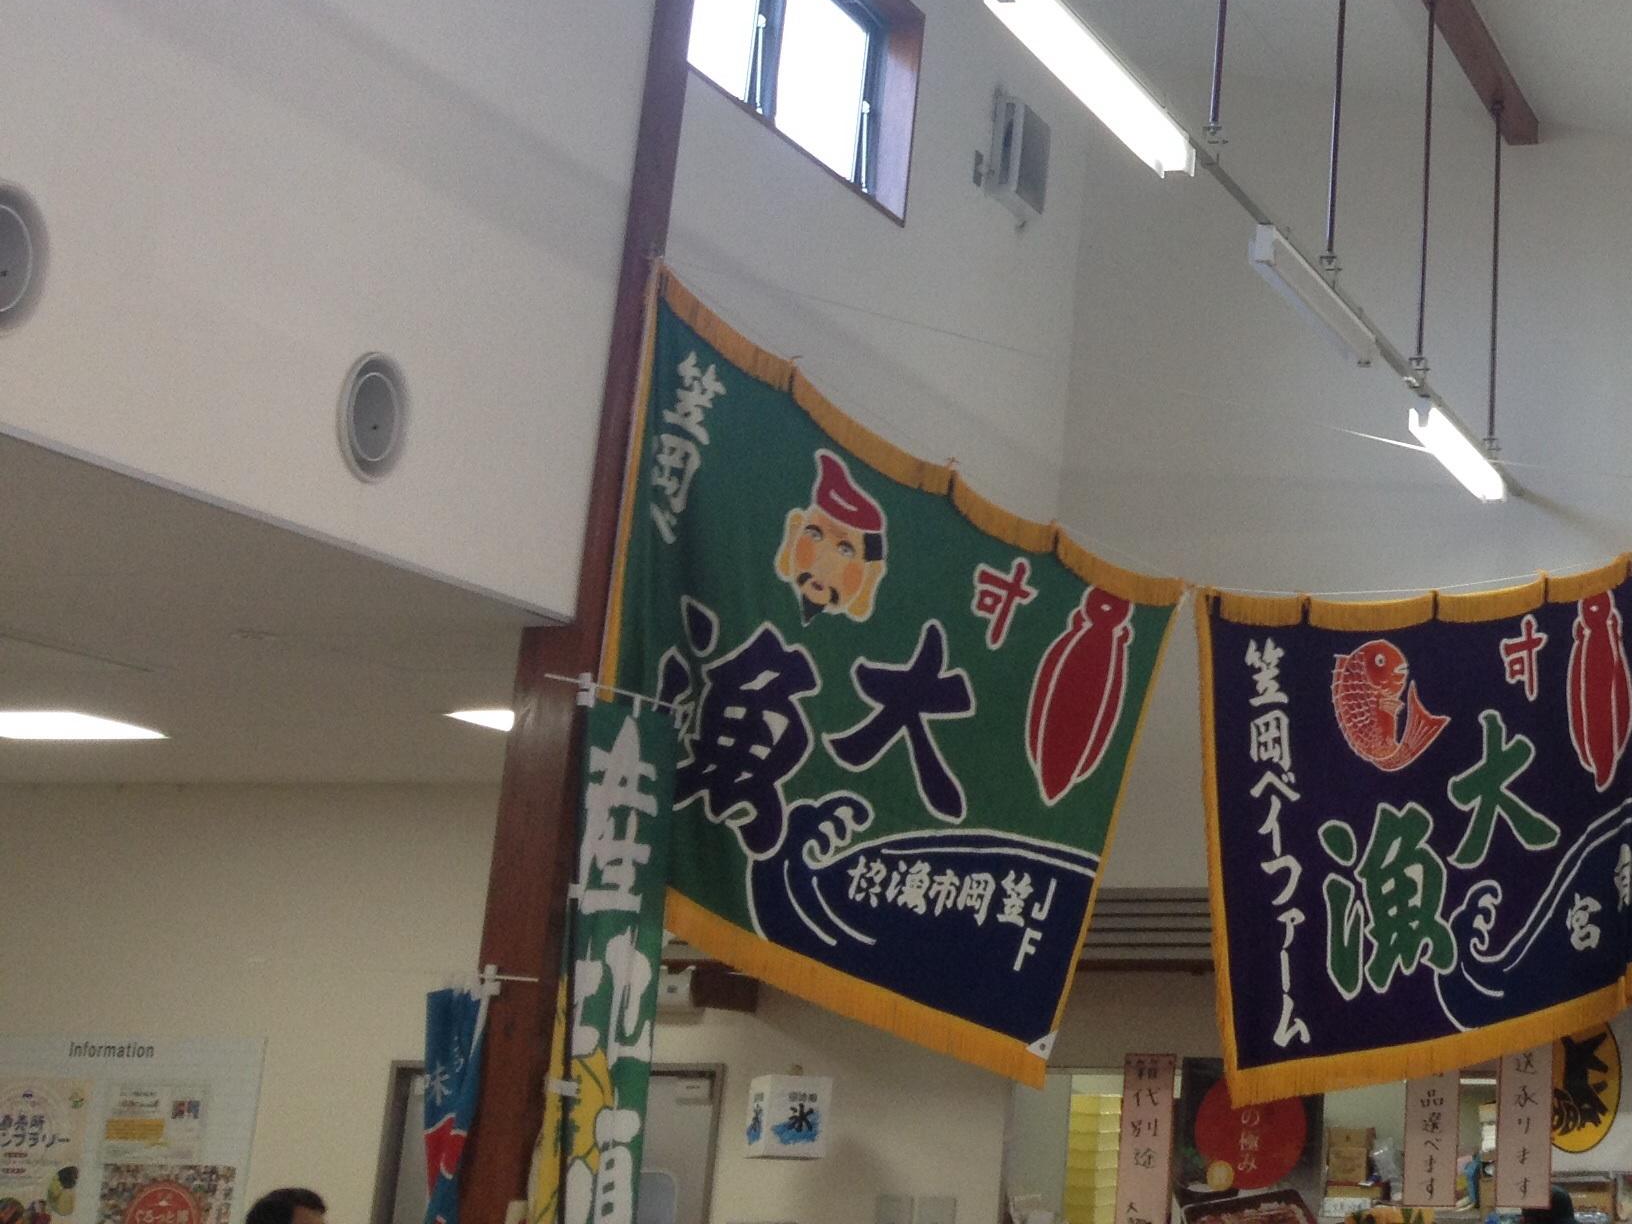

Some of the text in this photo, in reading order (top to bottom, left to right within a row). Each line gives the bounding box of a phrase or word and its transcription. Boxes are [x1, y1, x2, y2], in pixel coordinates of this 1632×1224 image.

[1244, 638, 1311, 1048] 笠岡ベイファーム
[69, 1041, 155, 1059] Information
[1420, 1072, 1445, 1201] 品選べます
